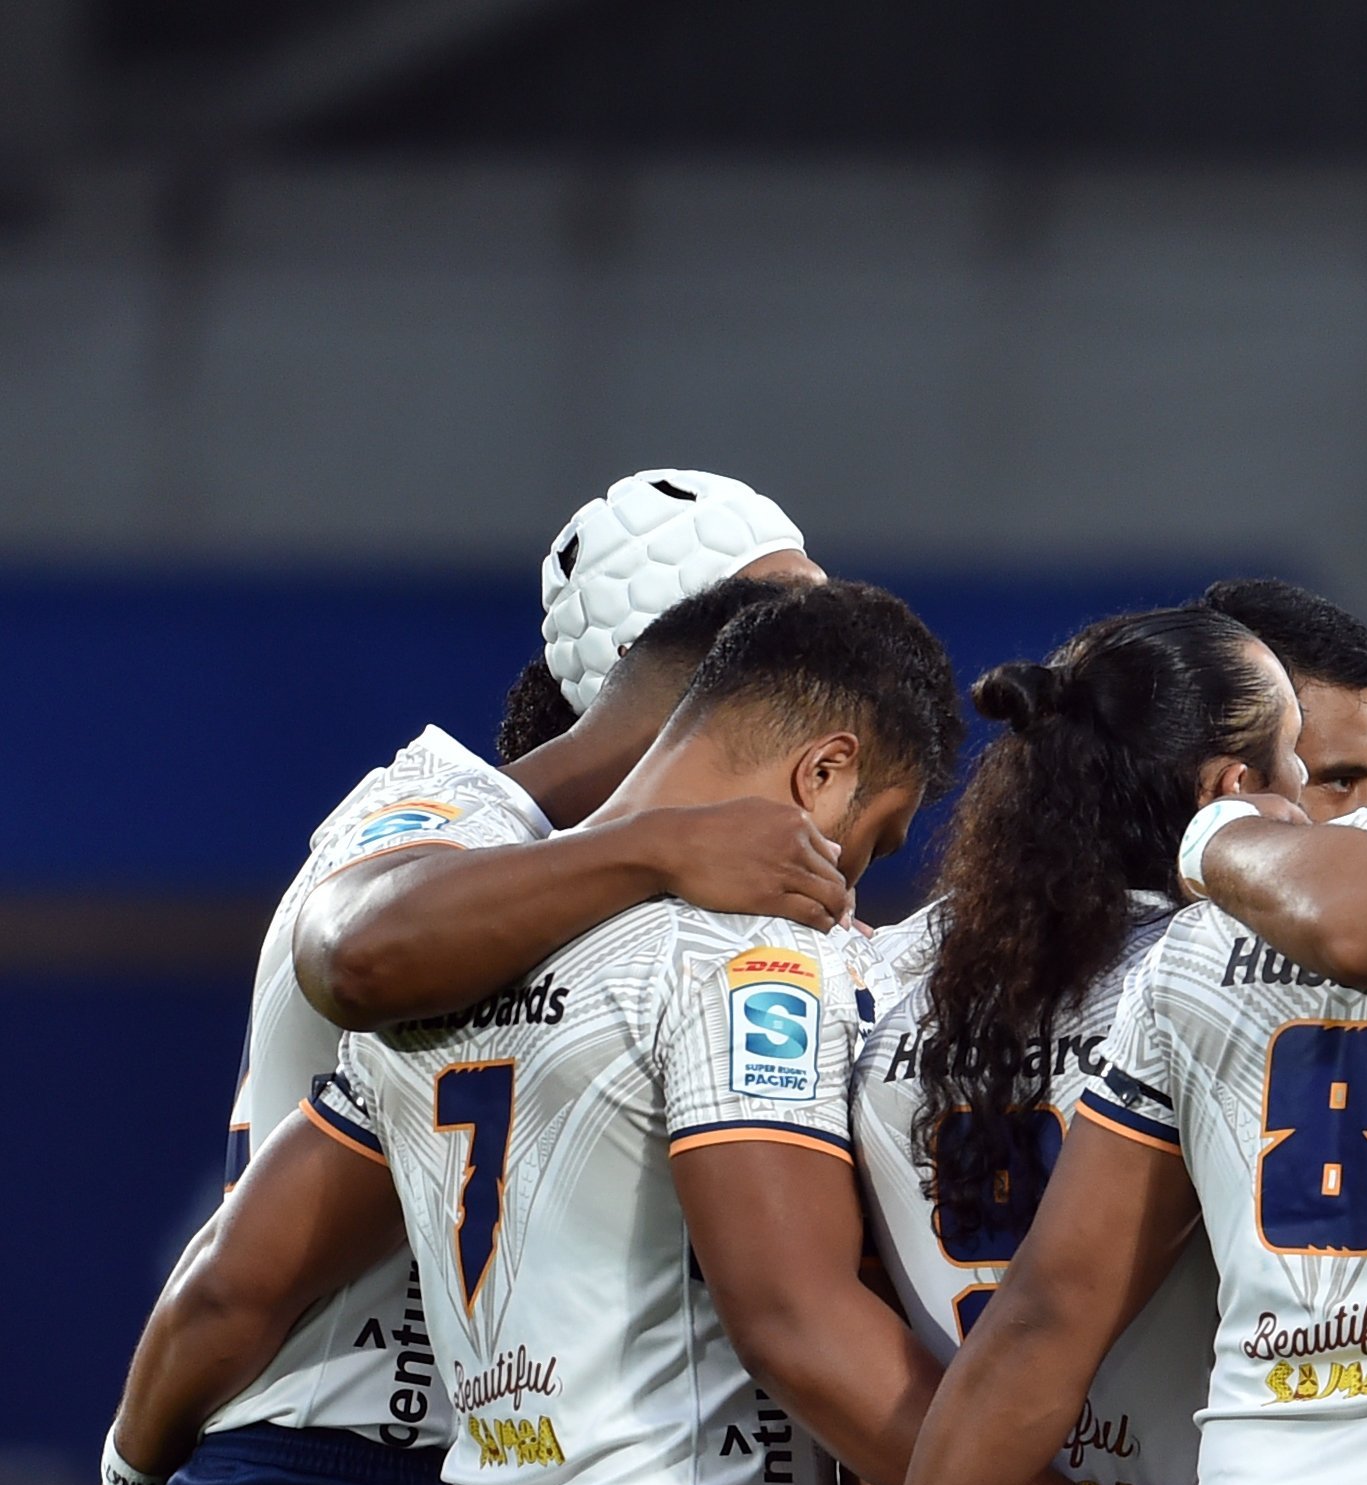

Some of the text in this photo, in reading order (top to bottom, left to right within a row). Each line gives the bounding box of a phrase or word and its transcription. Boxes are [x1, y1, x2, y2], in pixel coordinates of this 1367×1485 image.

[744, 1073, 808, 1091] PACIFIC
[745, 1064, 776, 1074] SUPER
[433, 1056, 516, 1321] 7
[453, 1344, 557, 1414] Beautiful
